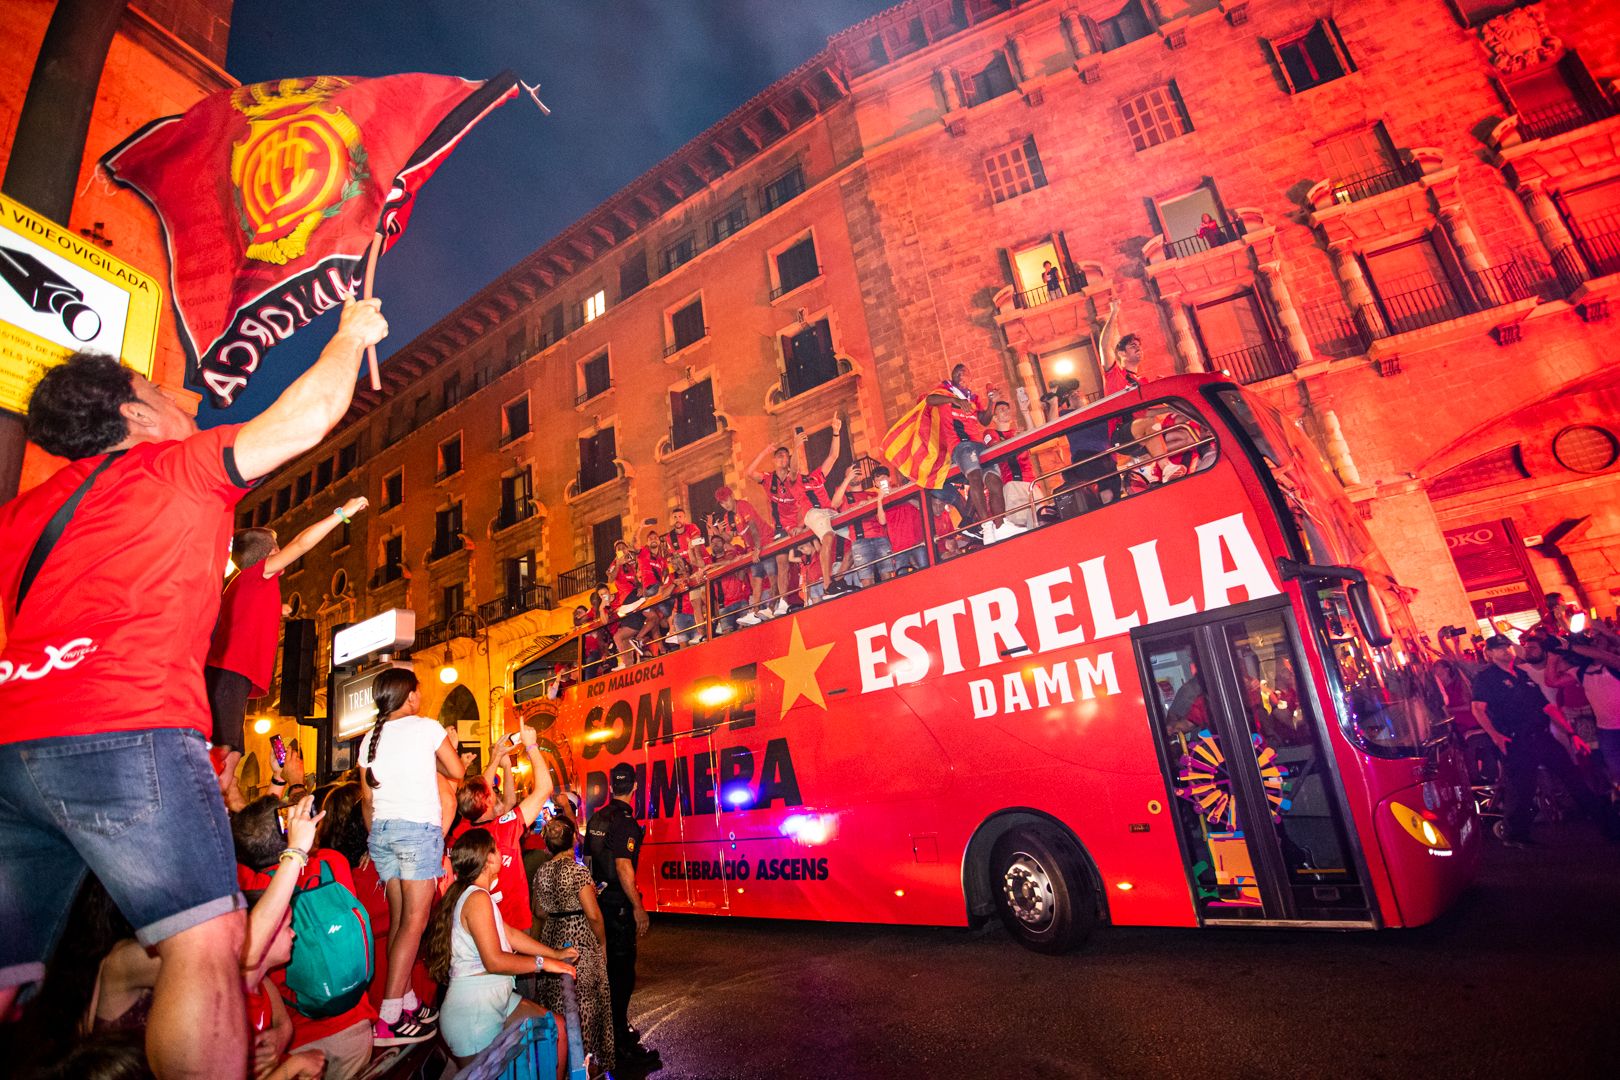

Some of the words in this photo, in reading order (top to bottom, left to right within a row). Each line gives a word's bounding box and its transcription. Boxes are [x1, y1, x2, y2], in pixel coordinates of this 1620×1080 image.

[13, 209, 150, 293] VIDEOVIGILADA
[853, 513, 1282, 694] ESTRELLA
[582, 687, 674, 760] SOM
[692, 662, 758, 739] DE
[587, 681, 605, 698] RCD
[608, 662, 665, 690] MALLORCA
[968, 651, 1121, 719] DAMM
[586, 737, 804, 823] PIMERA
[661, 854, 750, 880] CELEBRACIÓ
[755, 858, 829, 880] ASCENS
